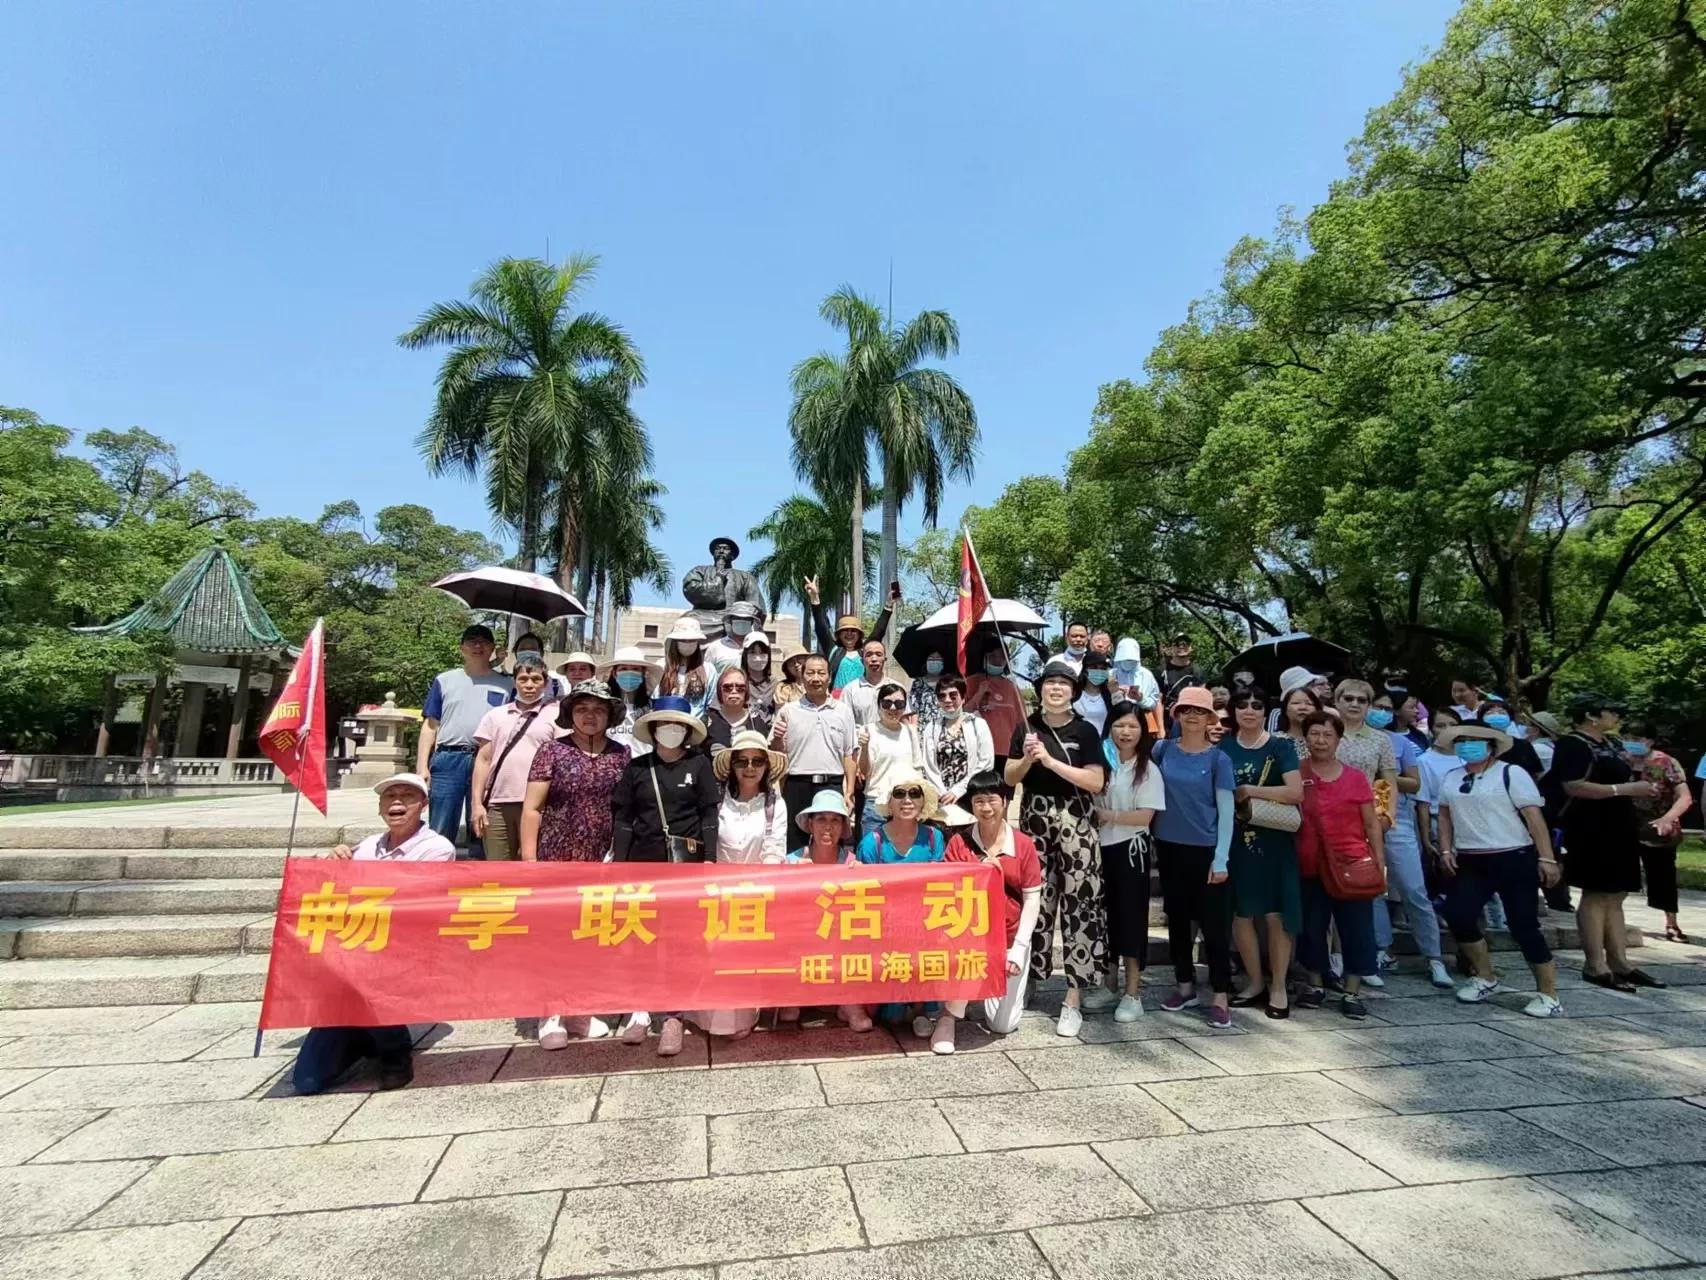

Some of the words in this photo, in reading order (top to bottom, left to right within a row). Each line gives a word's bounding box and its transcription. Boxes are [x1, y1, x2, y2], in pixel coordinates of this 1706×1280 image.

[295, 875, 990, 955] 畅享联谊活动
